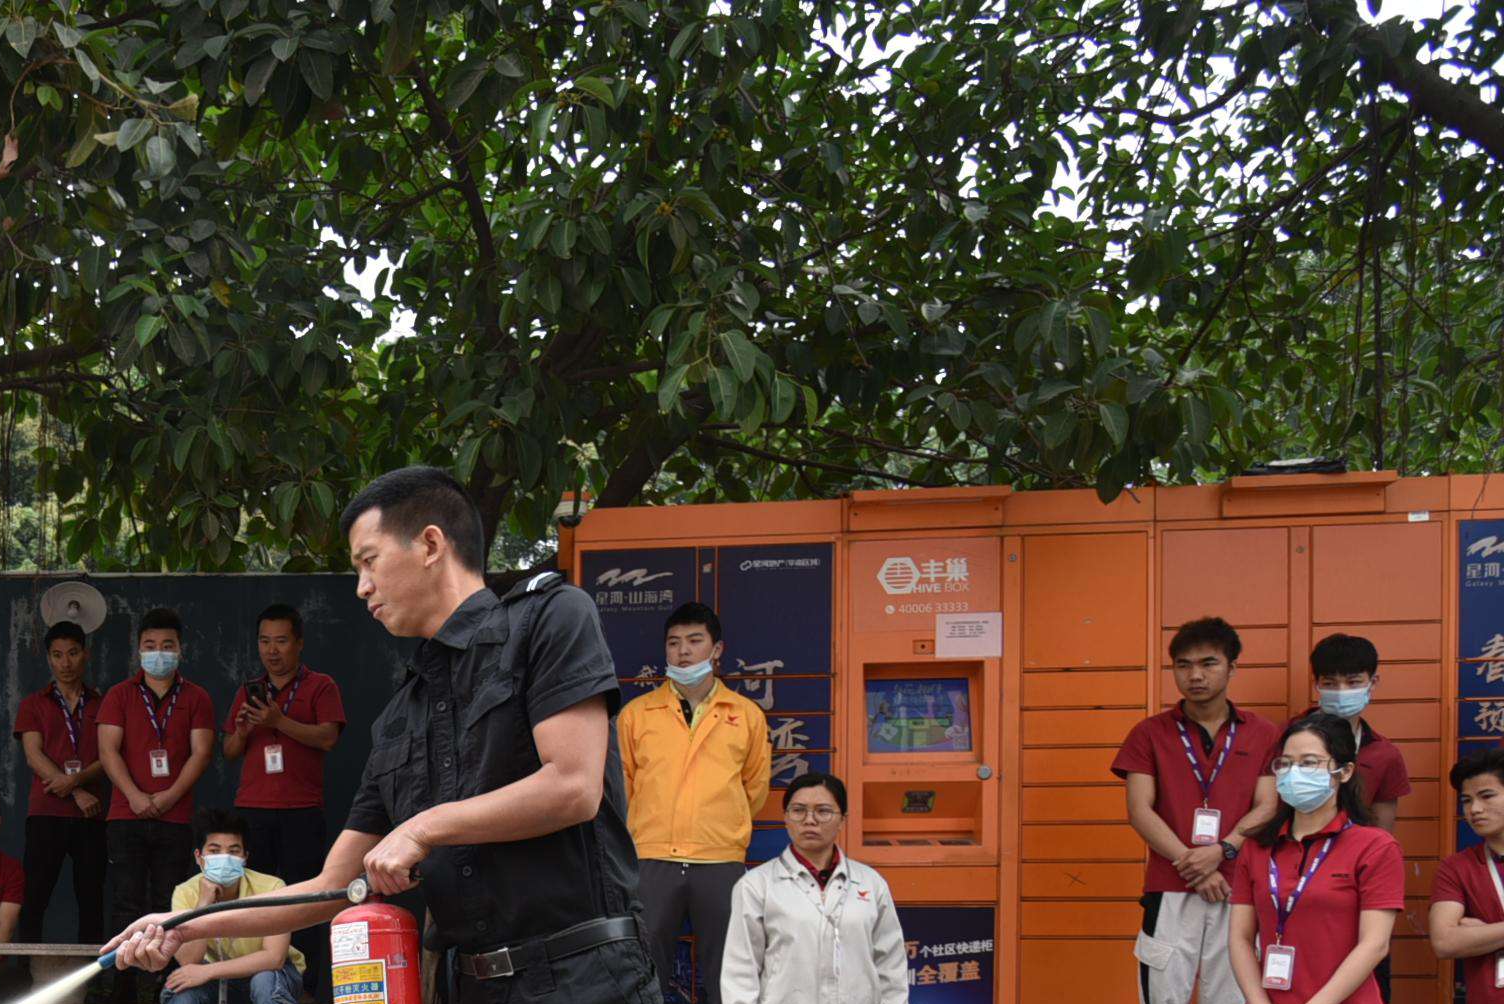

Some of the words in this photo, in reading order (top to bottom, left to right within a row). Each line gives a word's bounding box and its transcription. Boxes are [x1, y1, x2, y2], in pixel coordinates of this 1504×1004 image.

[920, 558, 969, 582] 丰巢
[912, 583, 942, 593] HIVE
[943, 582, 970, 593] BOX
[898, 603, 933, 614] 40006
[935, 601, 969, 613] 33333
